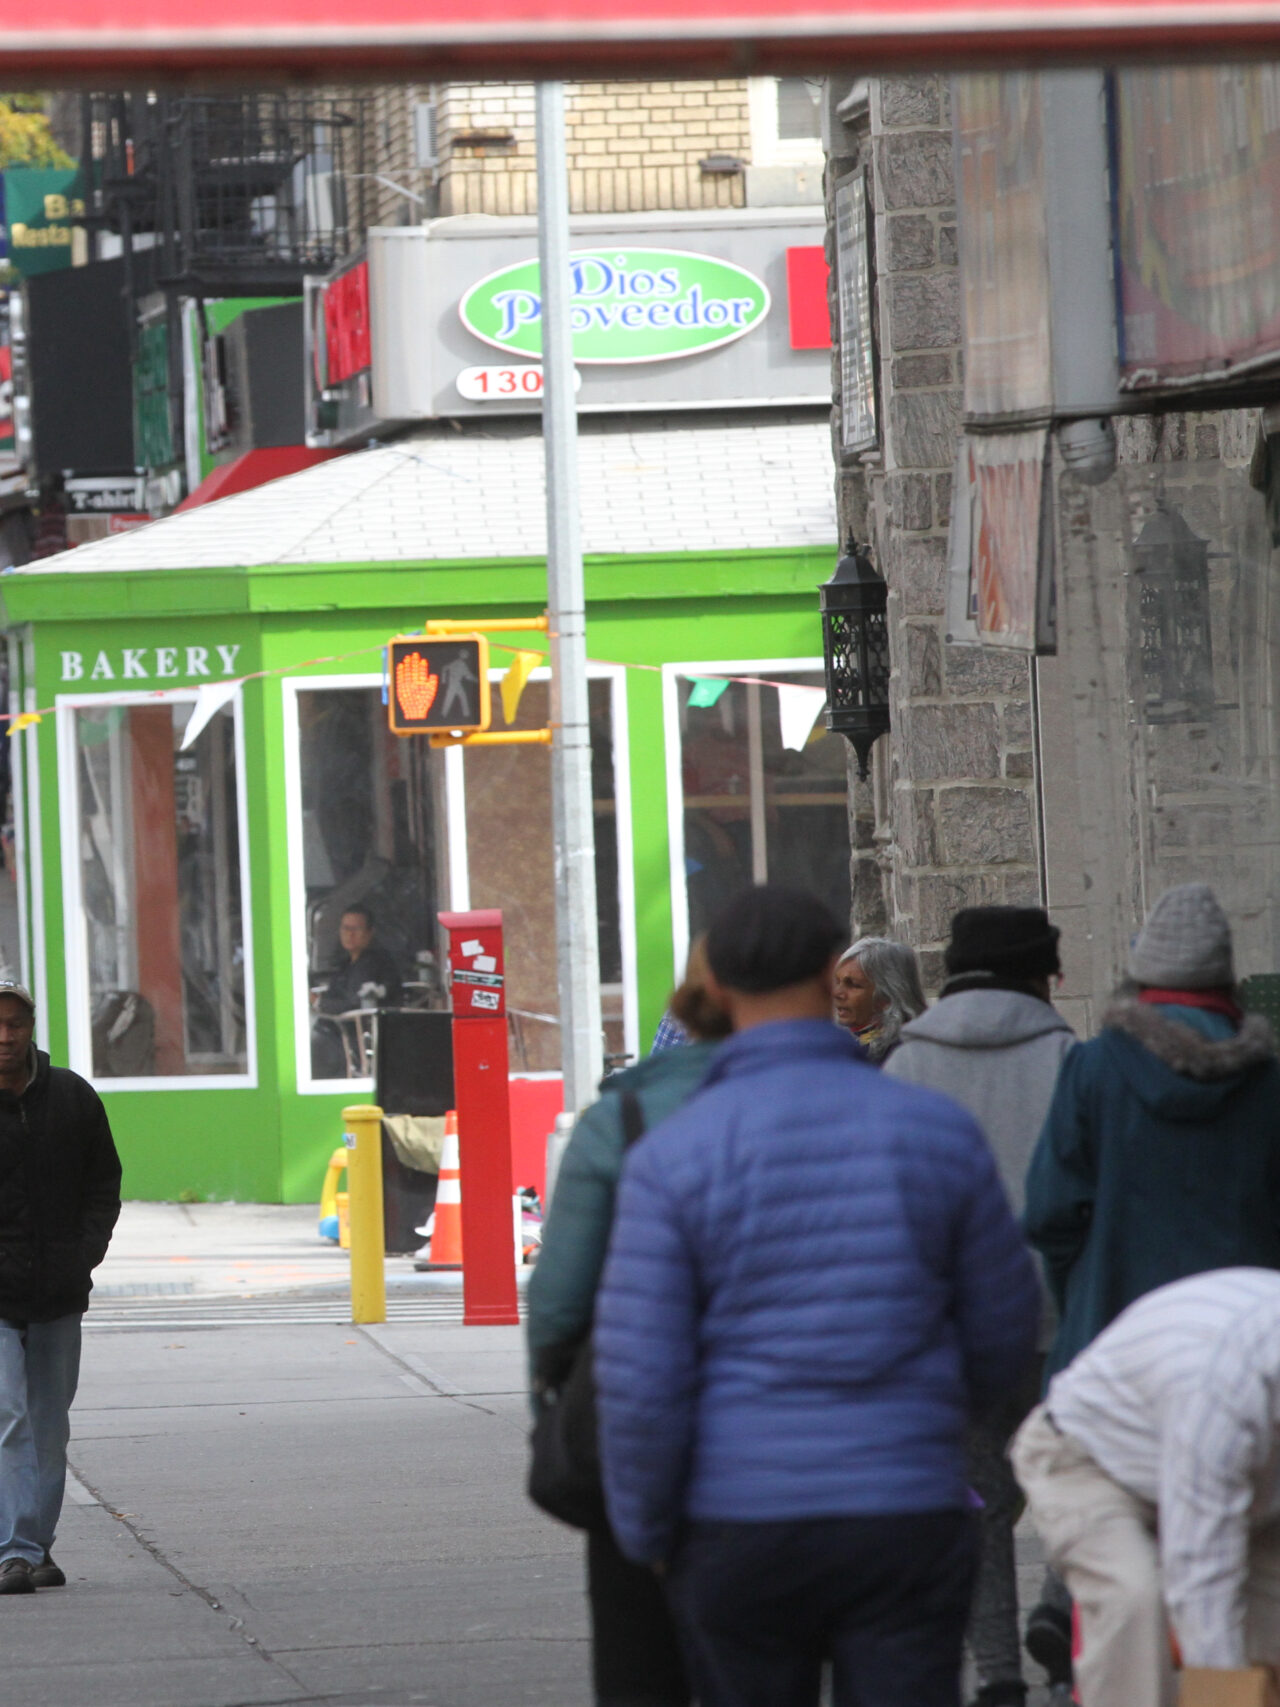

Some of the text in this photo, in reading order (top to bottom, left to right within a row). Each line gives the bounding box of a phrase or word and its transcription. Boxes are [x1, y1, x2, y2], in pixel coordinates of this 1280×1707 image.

[568, 255, 678, 297] Dios
[494, 286, 753, 337] Poveedor
[473, 369, 544, 394] 130
[60, 644, 241, 682] BAKERY
